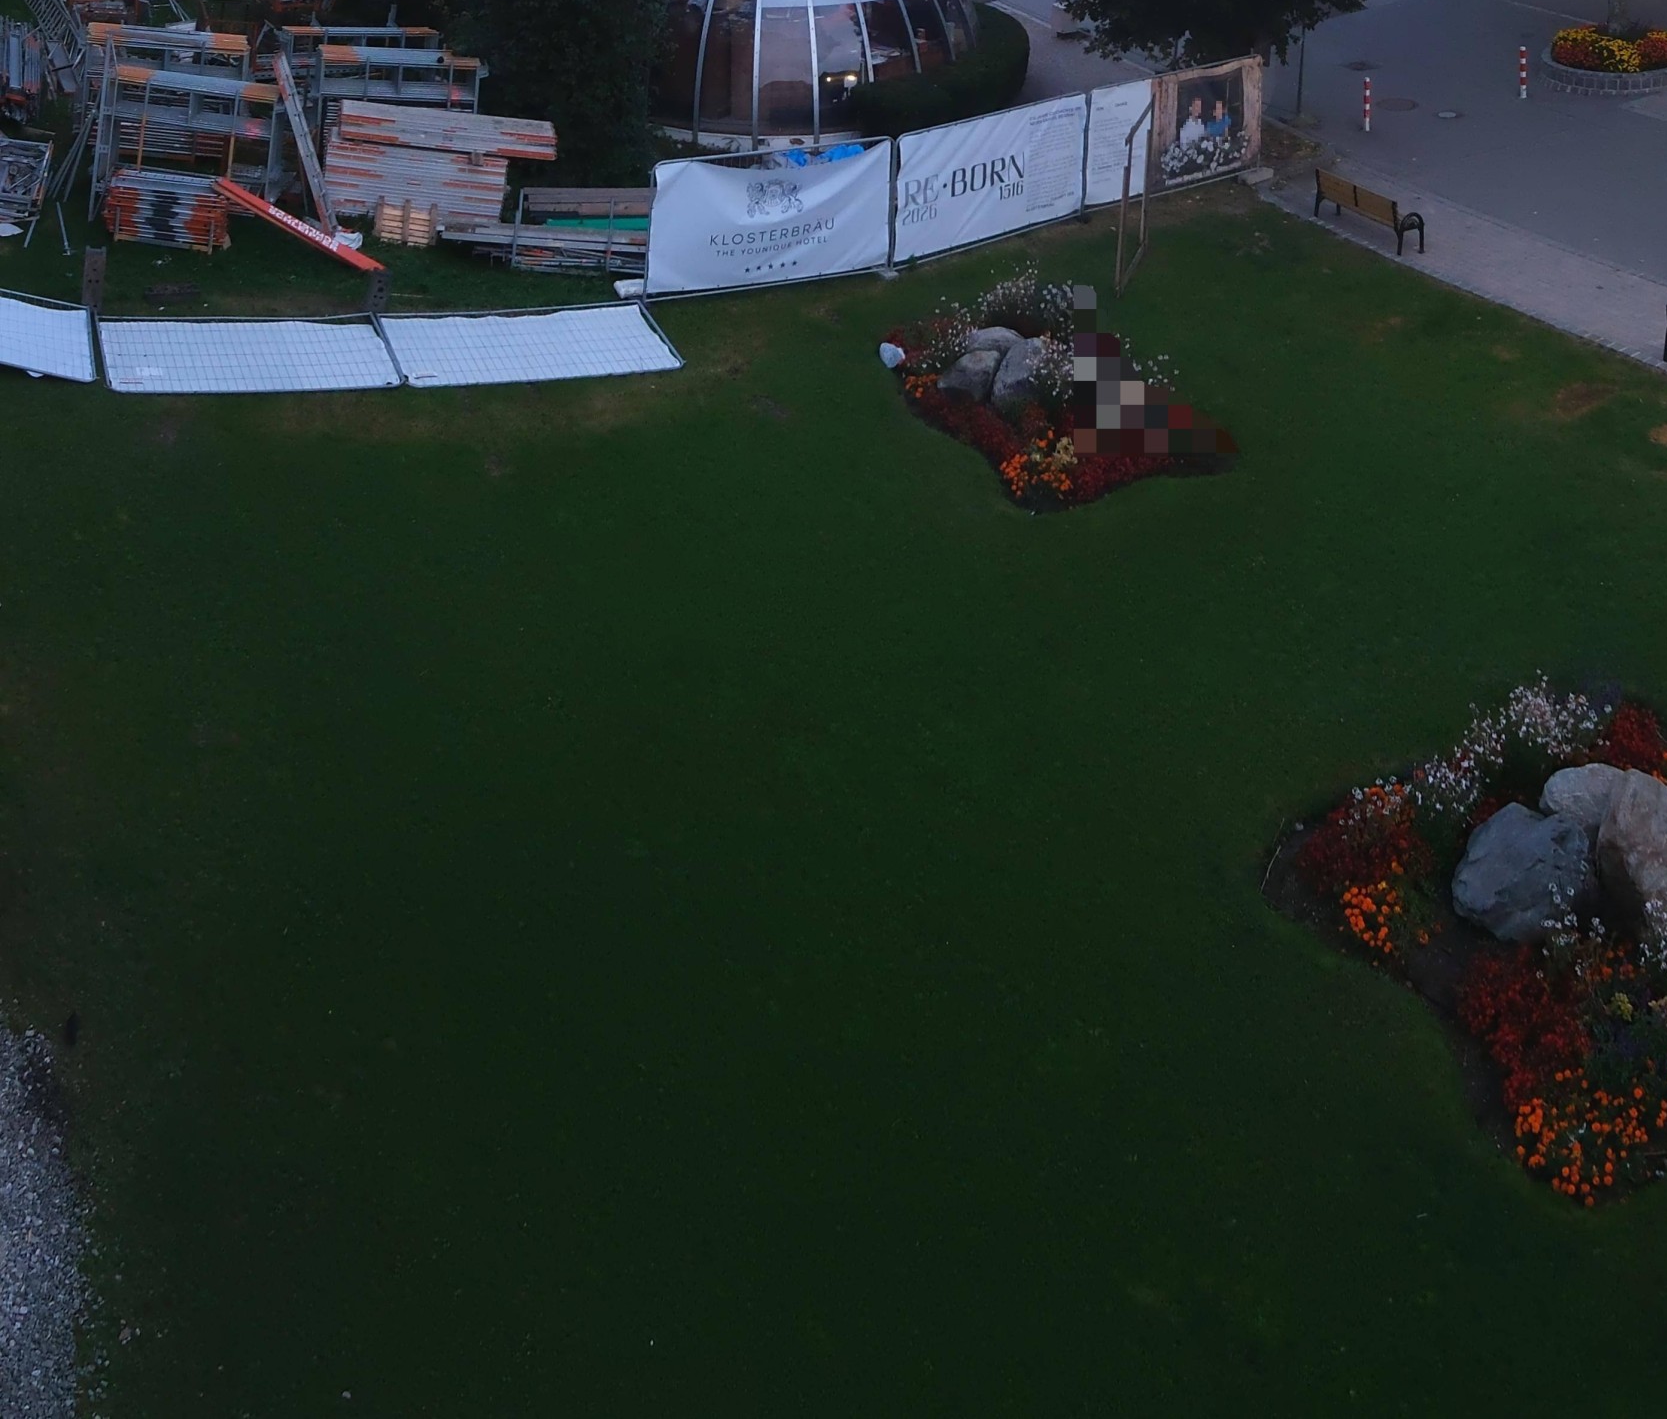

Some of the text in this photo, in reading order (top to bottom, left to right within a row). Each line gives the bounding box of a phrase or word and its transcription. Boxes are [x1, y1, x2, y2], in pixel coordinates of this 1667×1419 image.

[1000, 180, 1023, 200] 1516
[902, 204, 937, 226] 2026
[709, 217, 835, 247] KLOSTERBRÄU
[716, 235, 828, 257] THE YOUNIQUE HOTEL
